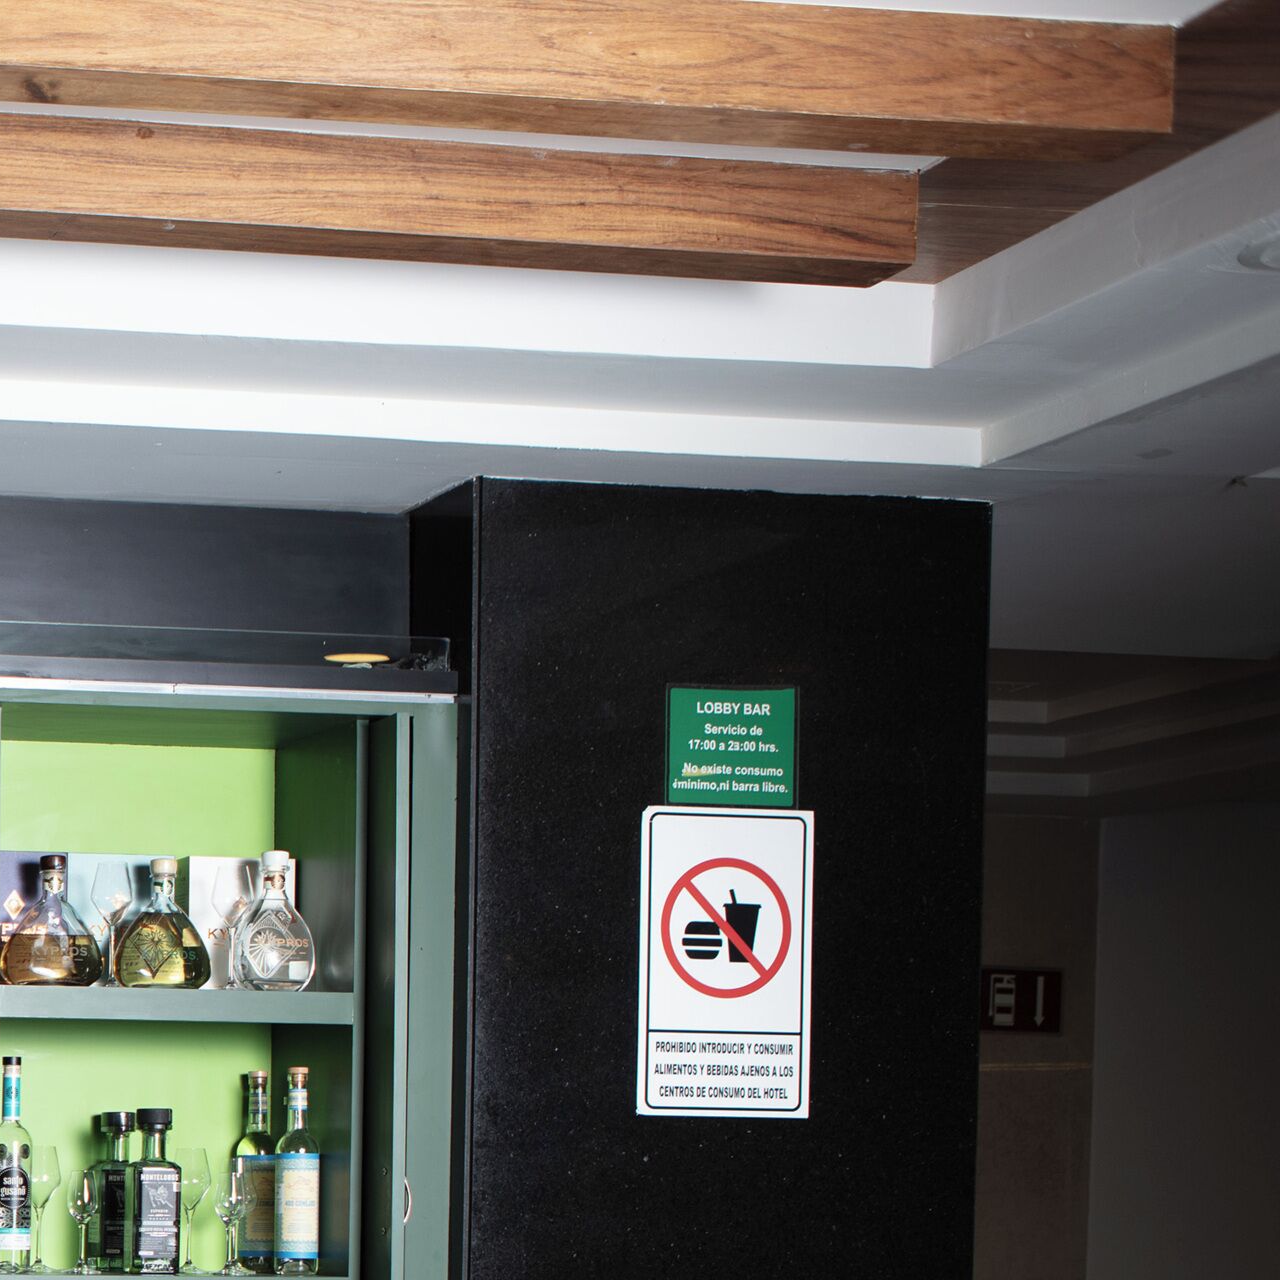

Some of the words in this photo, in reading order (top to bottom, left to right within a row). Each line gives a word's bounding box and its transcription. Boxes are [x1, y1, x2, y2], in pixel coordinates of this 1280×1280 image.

[696, 701, 741, 715] LOBBY
[743, 703, 771, 716] BAR
[704, 723, 747, 735] Servicio
[749, 725, 763, 736] de
[687, 739, 716, 750] 17:00
[718, 742, 725, 750] a
[758, 741, 779, 753] hrs.
[683, 762, 698, 774] No
[700, 763, 732, 775] existe
[734, 766, 784, 777] consumo
[732, 780, 760, 792] barra
[762, 781, 789, 793] libre.
[655, 1041, 697, 1053] PROHIBIDO
[698, 1042, 745, 1054] INTRODUCIR
[746, 1043, 753, 1054] Y
[753, 1043, 794, 1055] CONSUMIR
[654, 1063, 698, 1075] ALIMENTOS
[699, 1064, 705, 1075] Y
[706, 1064, 739, 1076] BEBIDAS
[740, 1065, 770, 1077] AJENOS
[771, 1066, 778, 1077] A
[779, 1066, 794, 1077] LOS
[659, 1085, 695, 1098] CENTROS
[696, 1086, 706, 1098] DE
[707, 1086, 745, 1099] CONSUMO
[747, 1087, 762, 1099] DEL
[763, 1088, 788, 1099] HOTEL
